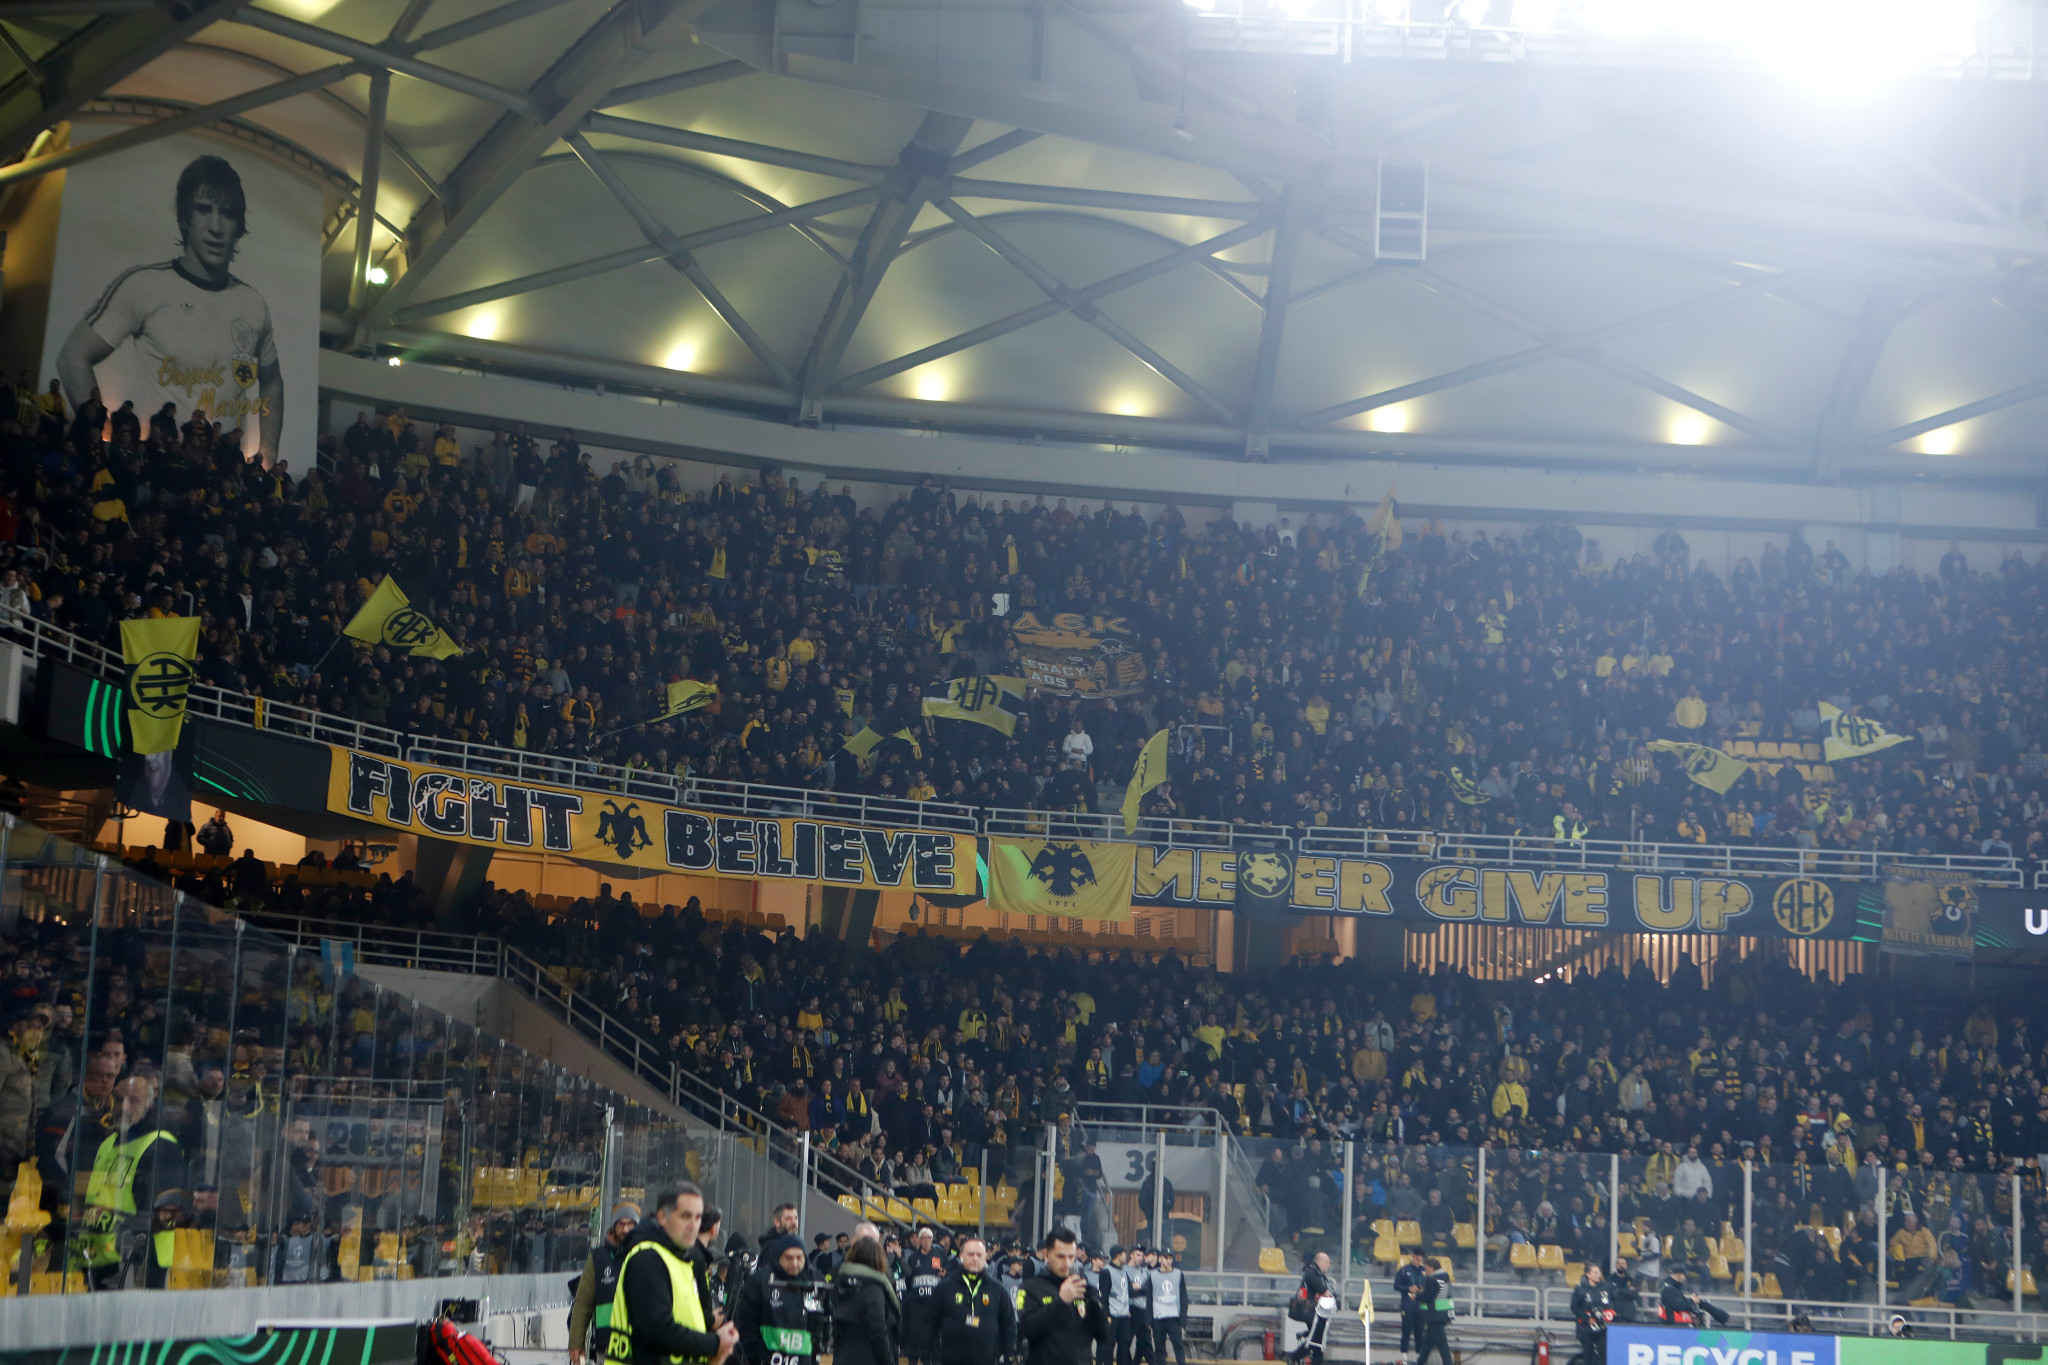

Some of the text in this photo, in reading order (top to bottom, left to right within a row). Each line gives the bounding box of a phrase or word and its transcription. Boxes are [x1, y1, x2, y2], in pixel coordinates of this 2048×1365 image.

[135, 657, 192, 713] AEK
[348, 751, 955, 889] FIGHT BELIEVE
[1133, 845, 1831, 933] NEER GIVE UP AEK
[780, 1331, 803, 1350] HB
